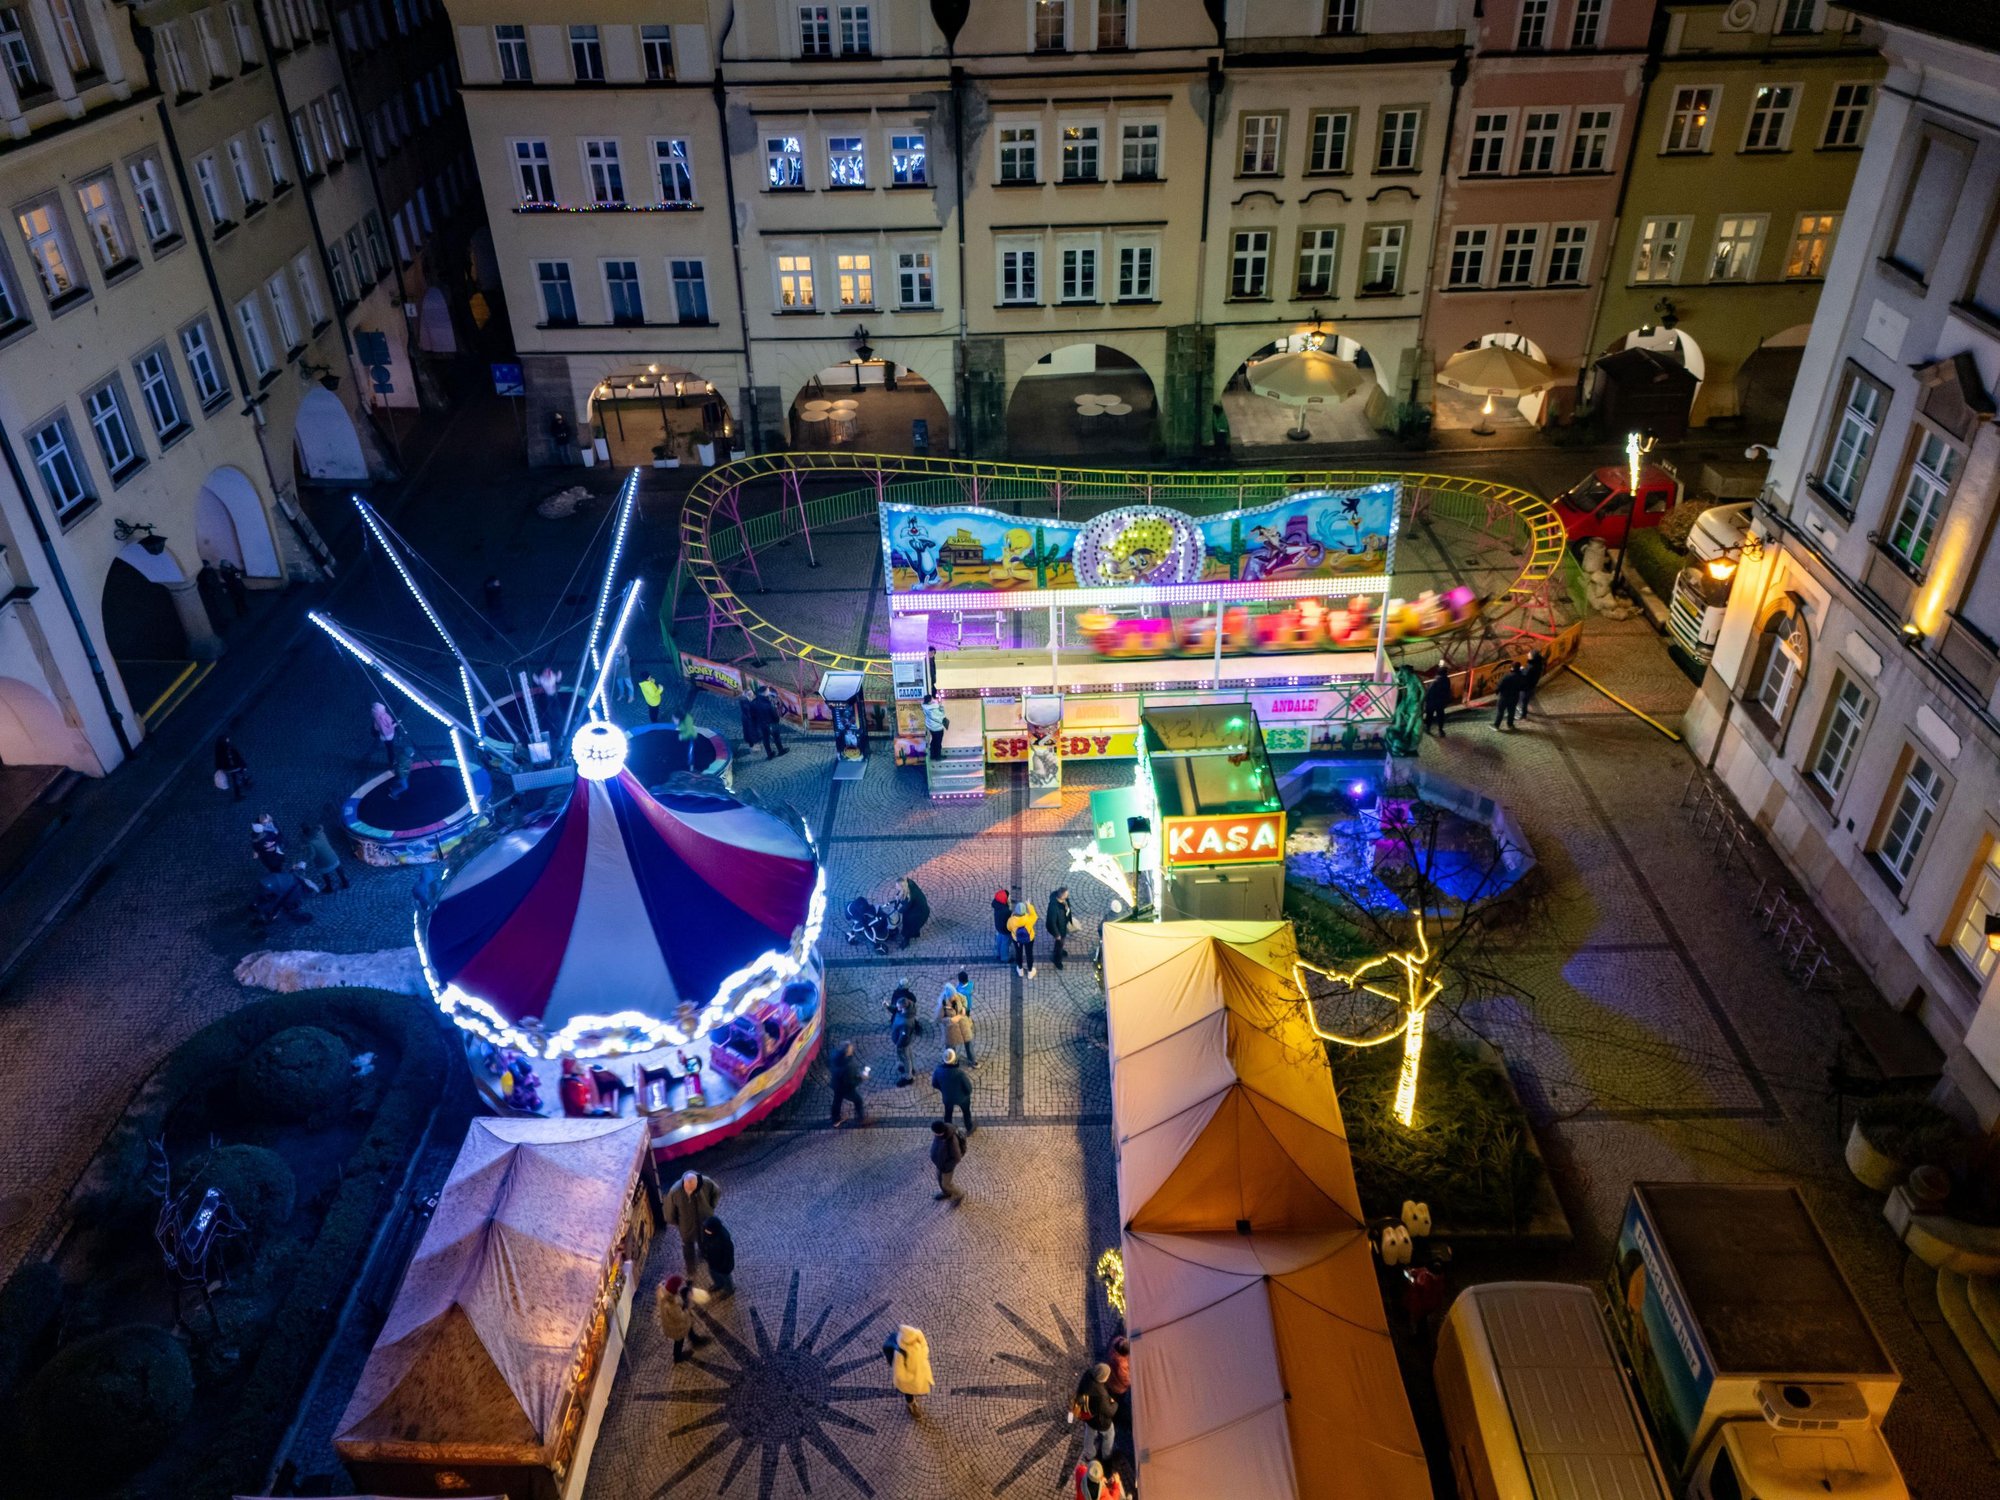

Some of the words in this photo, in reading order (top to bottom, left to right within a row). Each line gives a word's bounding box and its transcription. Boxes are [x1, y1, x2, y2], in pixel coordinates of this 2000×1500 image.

[686, 665, 714, 676] LOONEY
[715, 671, 738, 689] TUNES
[899, 688, 923, 698] SALOON
[1271, 699, 1319, 713] ANDALE!
[993, 735, 1111, 758] SPDY
[1169, 822, 1277, 855] KASA
[1637, 1230, 1665, 1295] Fleisch
[1678, 1326, 1697, 1368] hier
